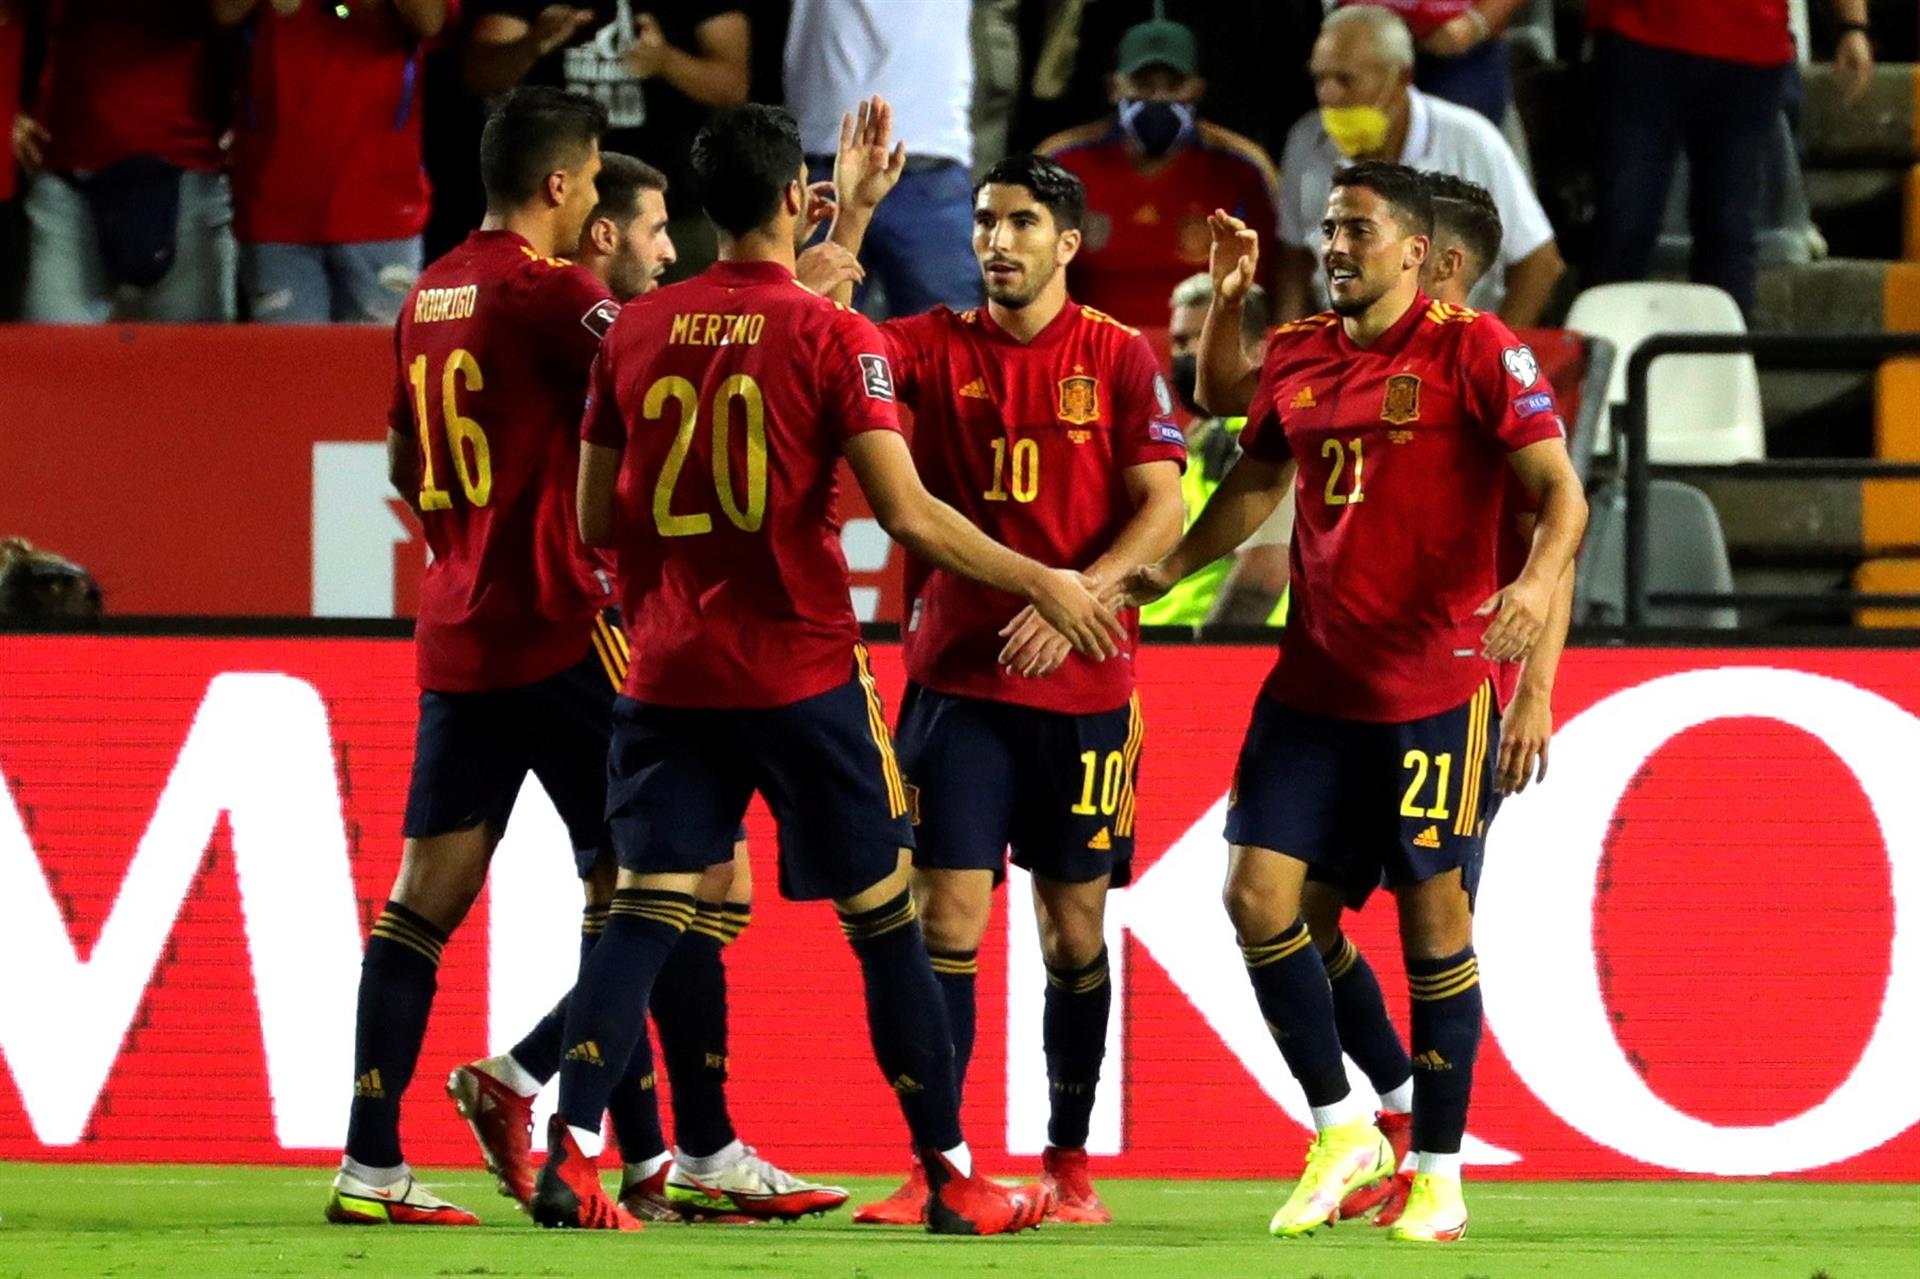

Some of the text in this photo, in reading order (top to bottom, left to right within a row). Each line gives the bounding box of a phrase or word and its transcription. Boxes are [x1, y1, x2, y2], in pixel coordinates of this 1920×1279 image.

[414, 285, 478, 323] RODRIGO
[669, 313, 765, 346] MERINO
[409, 348, 492, 511] 16
[643, 374, 767, 536] 20
[983, 437, 1039, 503] 10
[1321, 438, 1364, 505] 21
[1071, 750, 1123, 816] 10
[1400, 749, 1452, 820] 21
